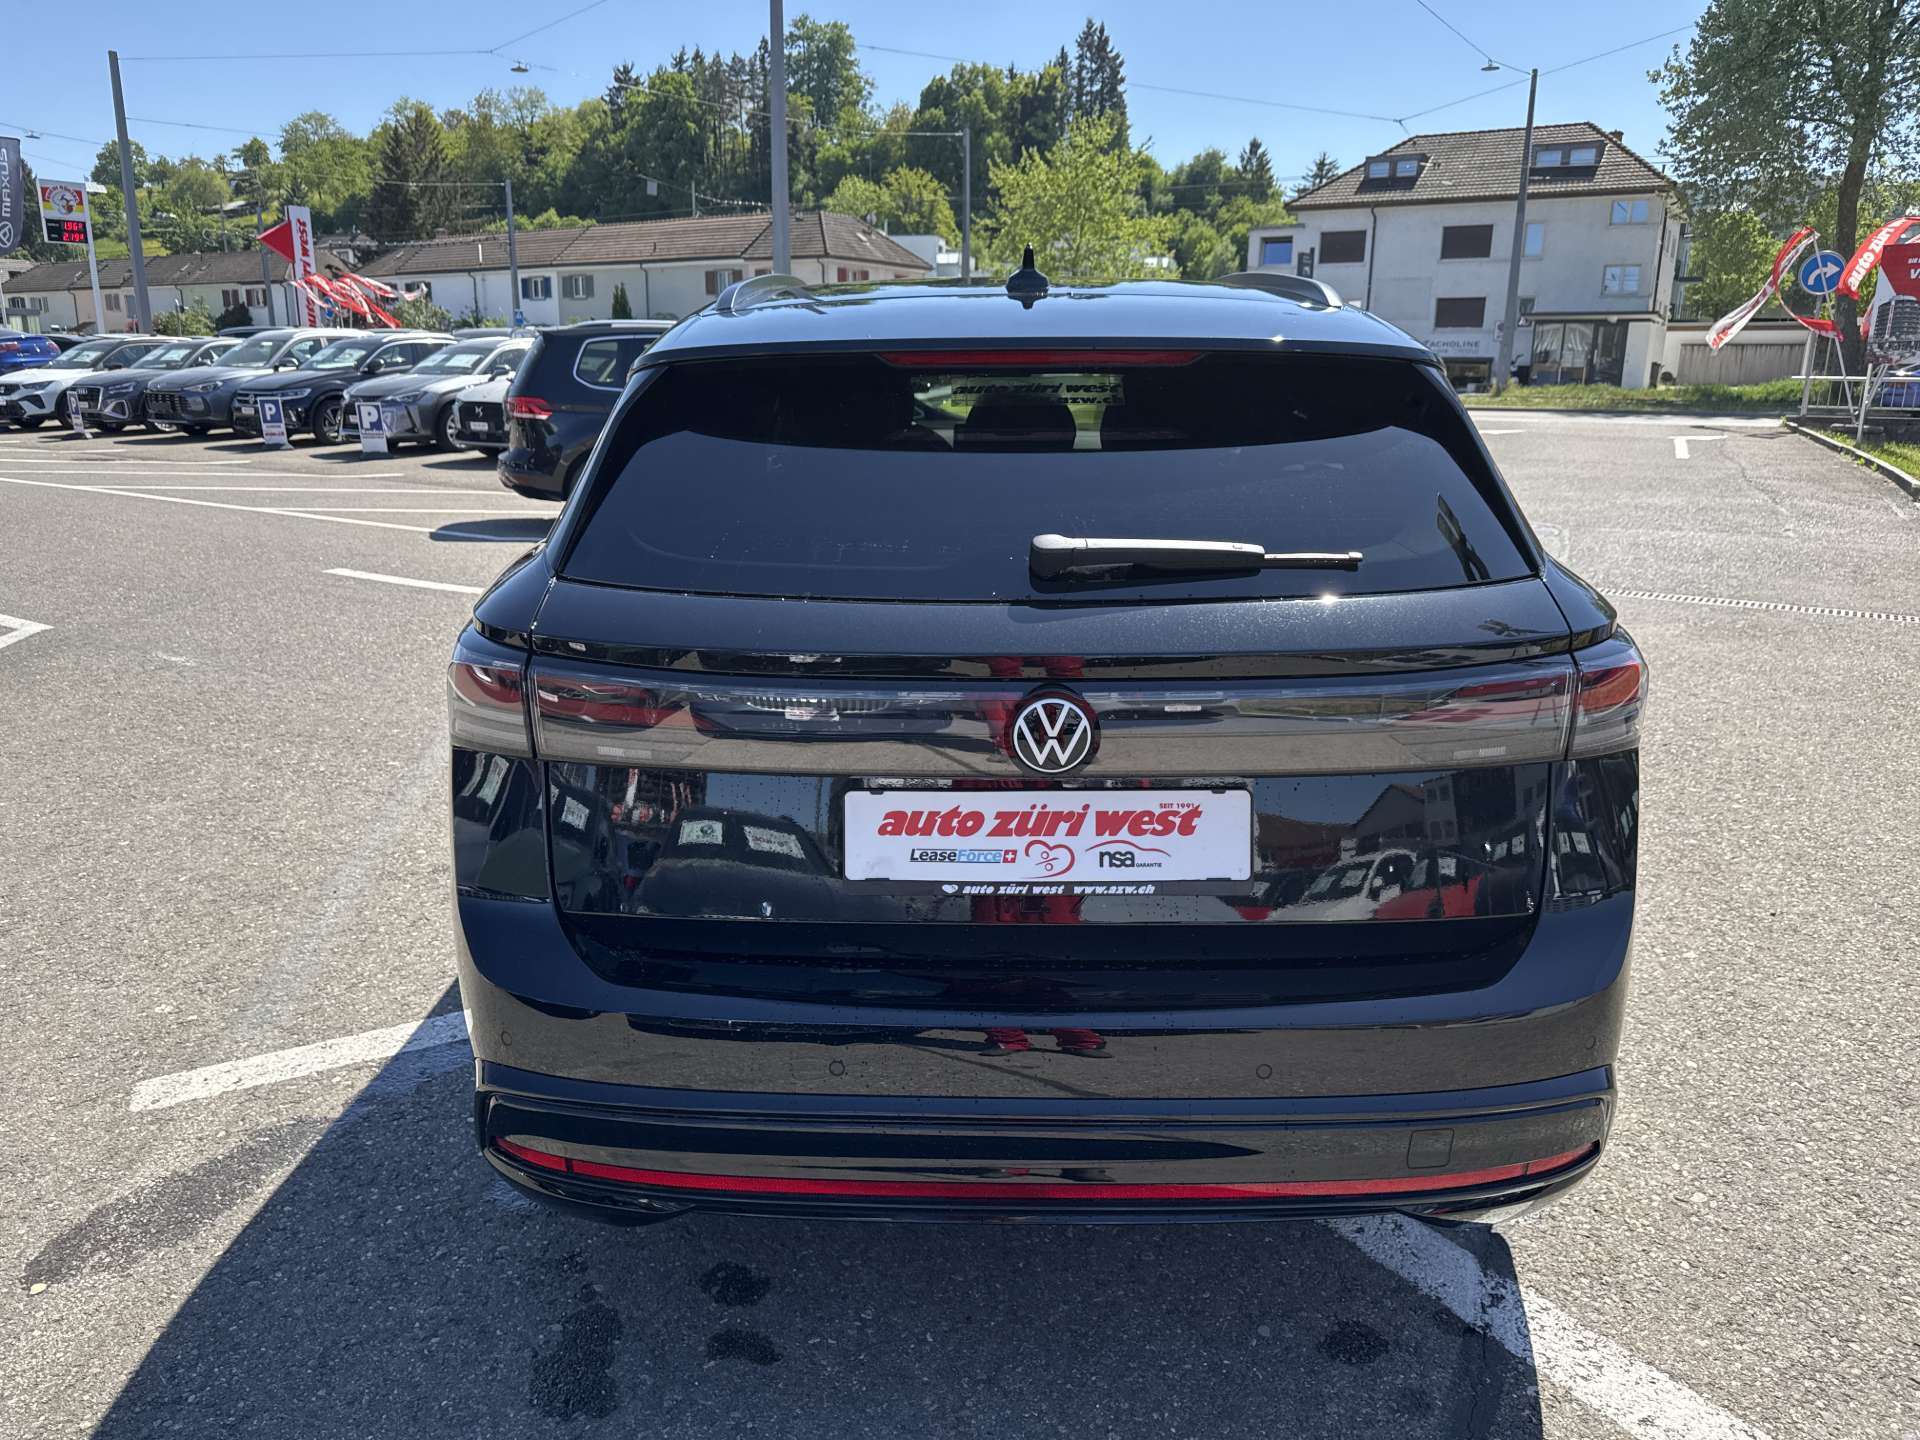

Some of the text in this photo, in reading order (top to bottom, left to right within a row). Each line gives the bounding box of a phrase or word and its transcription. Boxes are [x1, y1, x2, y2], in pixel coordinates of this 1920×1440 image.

[0, 147, 11, 217] MAXUS
[264, 403, 276, 421] P
[360, 405, 379, 429] P
[877, 803, 1203, 837] auto züri west
[909, 848, 1001, 863] LeaseForce
[1099, 850, 1135, 868] nsa
[962, 883, 1156, 895] auto züri west www.azw.ch
